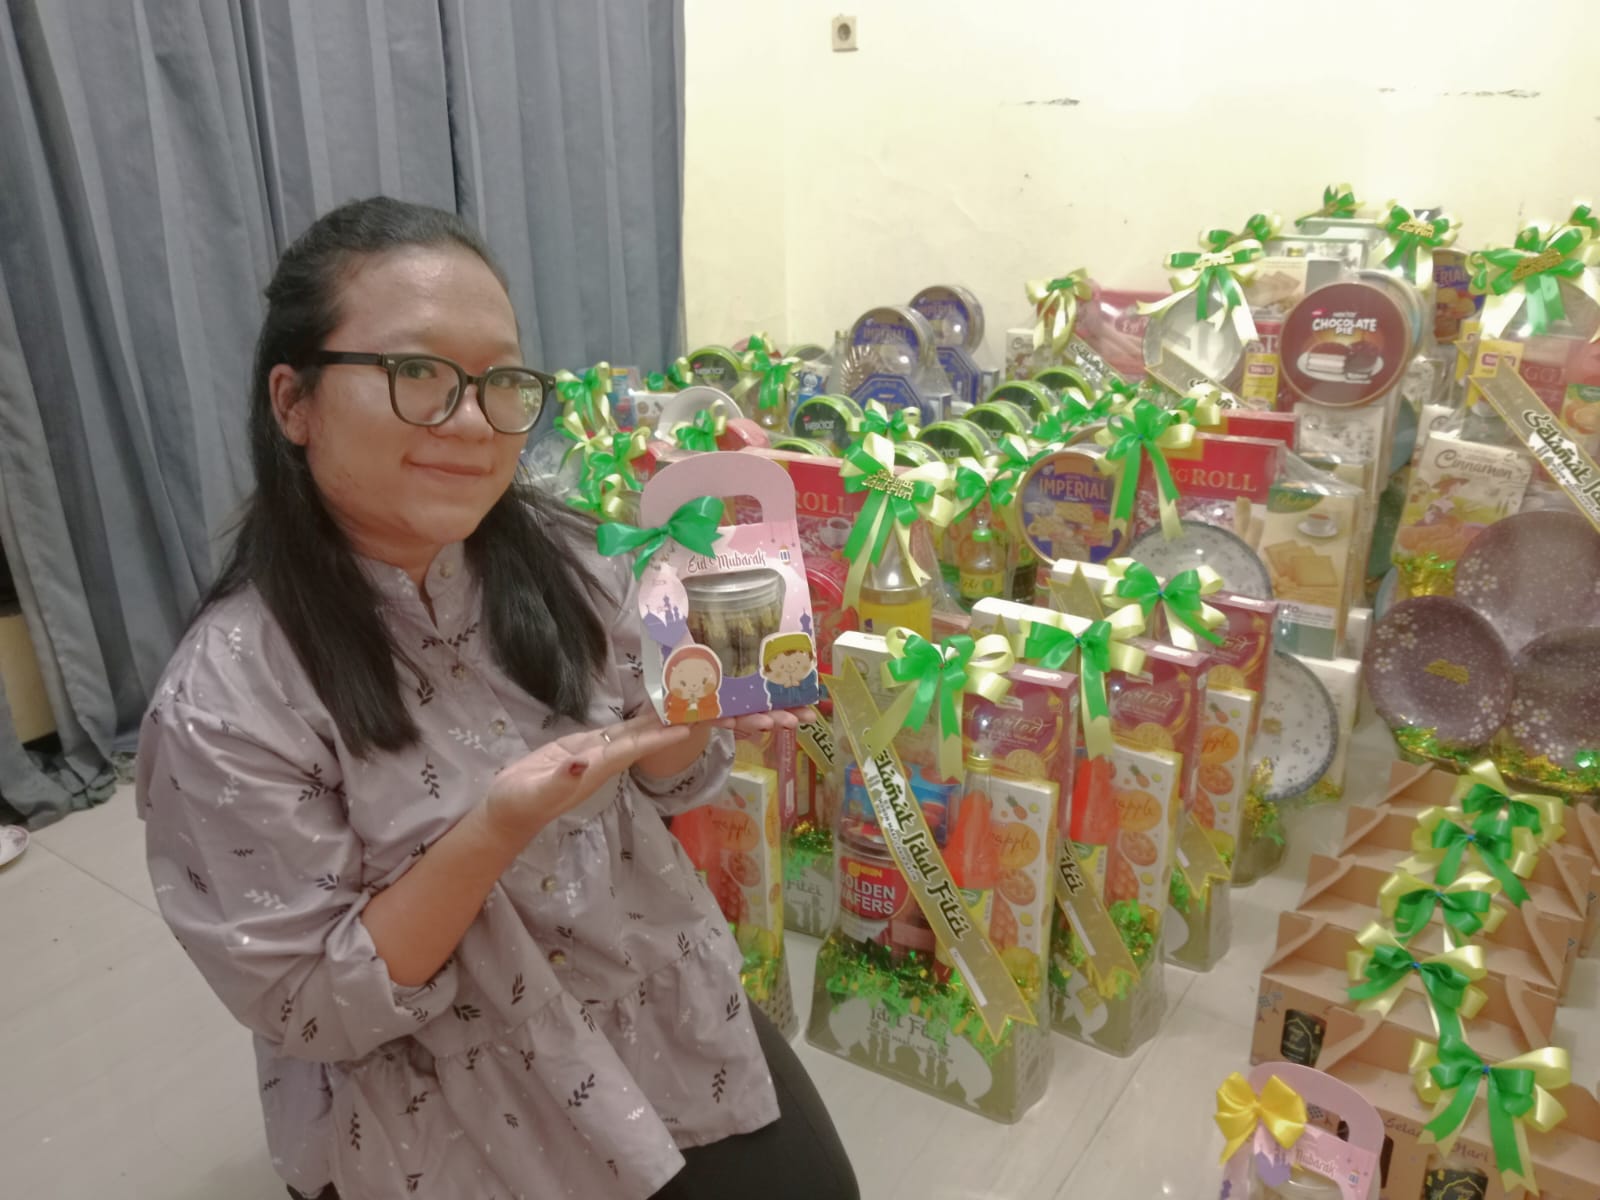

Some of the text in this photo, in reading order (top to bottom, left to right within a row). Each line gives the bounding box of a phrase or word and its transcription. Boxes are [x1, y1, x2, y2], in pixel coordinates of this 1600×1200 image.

[1312, 318, 1377, 332] CHOCOLATE
[1335, 327, 1353, 335] PIE
[1521, 410, 1592, 485] Selamat
[1434, 449, 1514, 480] Cinnamon
[1039, 477, 1108, 500] IMPERIAL
[1192, 468, 1257, 492] ROLL
[797, 492, 851, 515] OLL
[716, 549, 767, 570] Mubarak
[873, 748, 916, 833] elamat
[902, 832, 940, 882] Idul
[927, 879, 971, 940] Fitri
[1454, 1143, 1489, 1162] Hari
